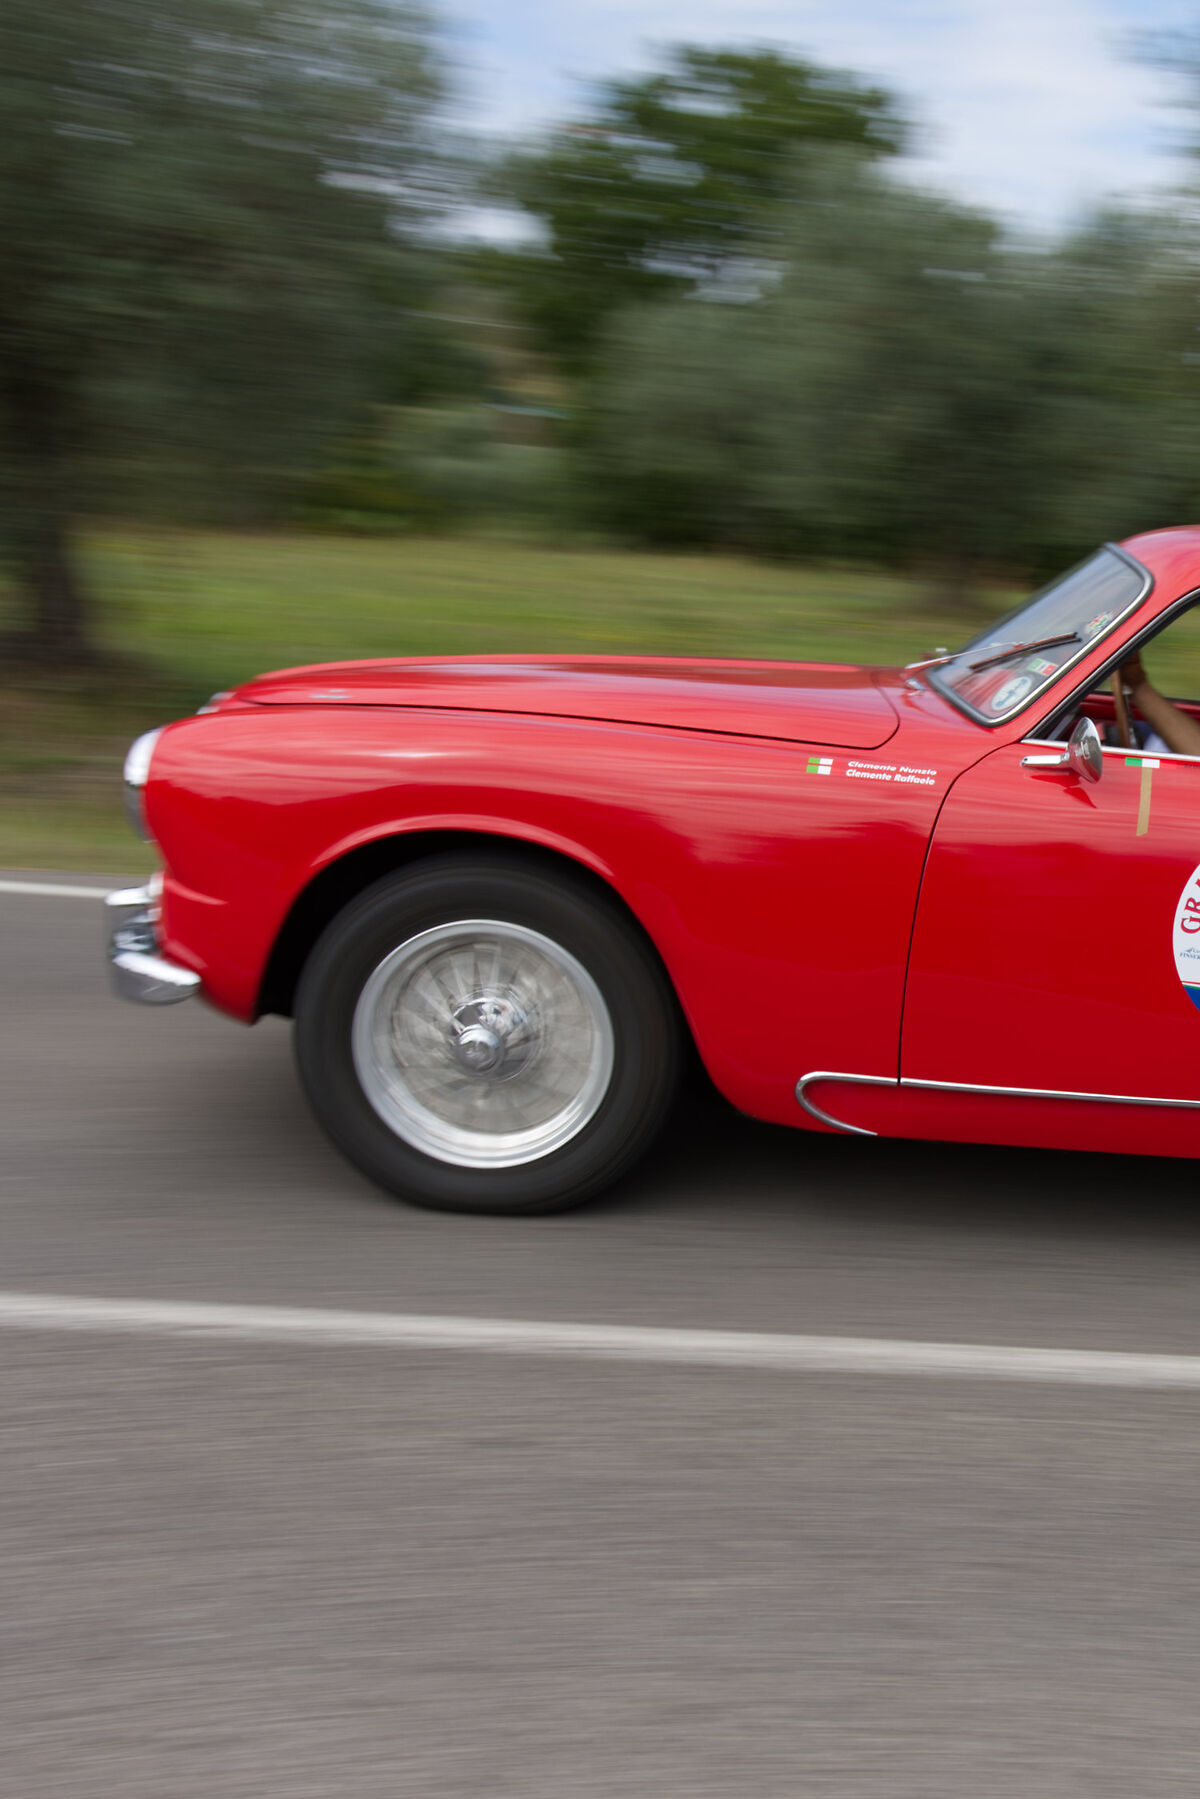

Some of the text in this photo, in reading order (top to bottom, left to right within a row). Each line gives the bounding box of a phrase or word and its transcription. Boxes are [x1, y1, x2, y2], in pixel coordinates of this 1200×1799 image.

[848, 761, 897, 771] Clemente
[846, 769, 935, 785] Clemente Raffaele
